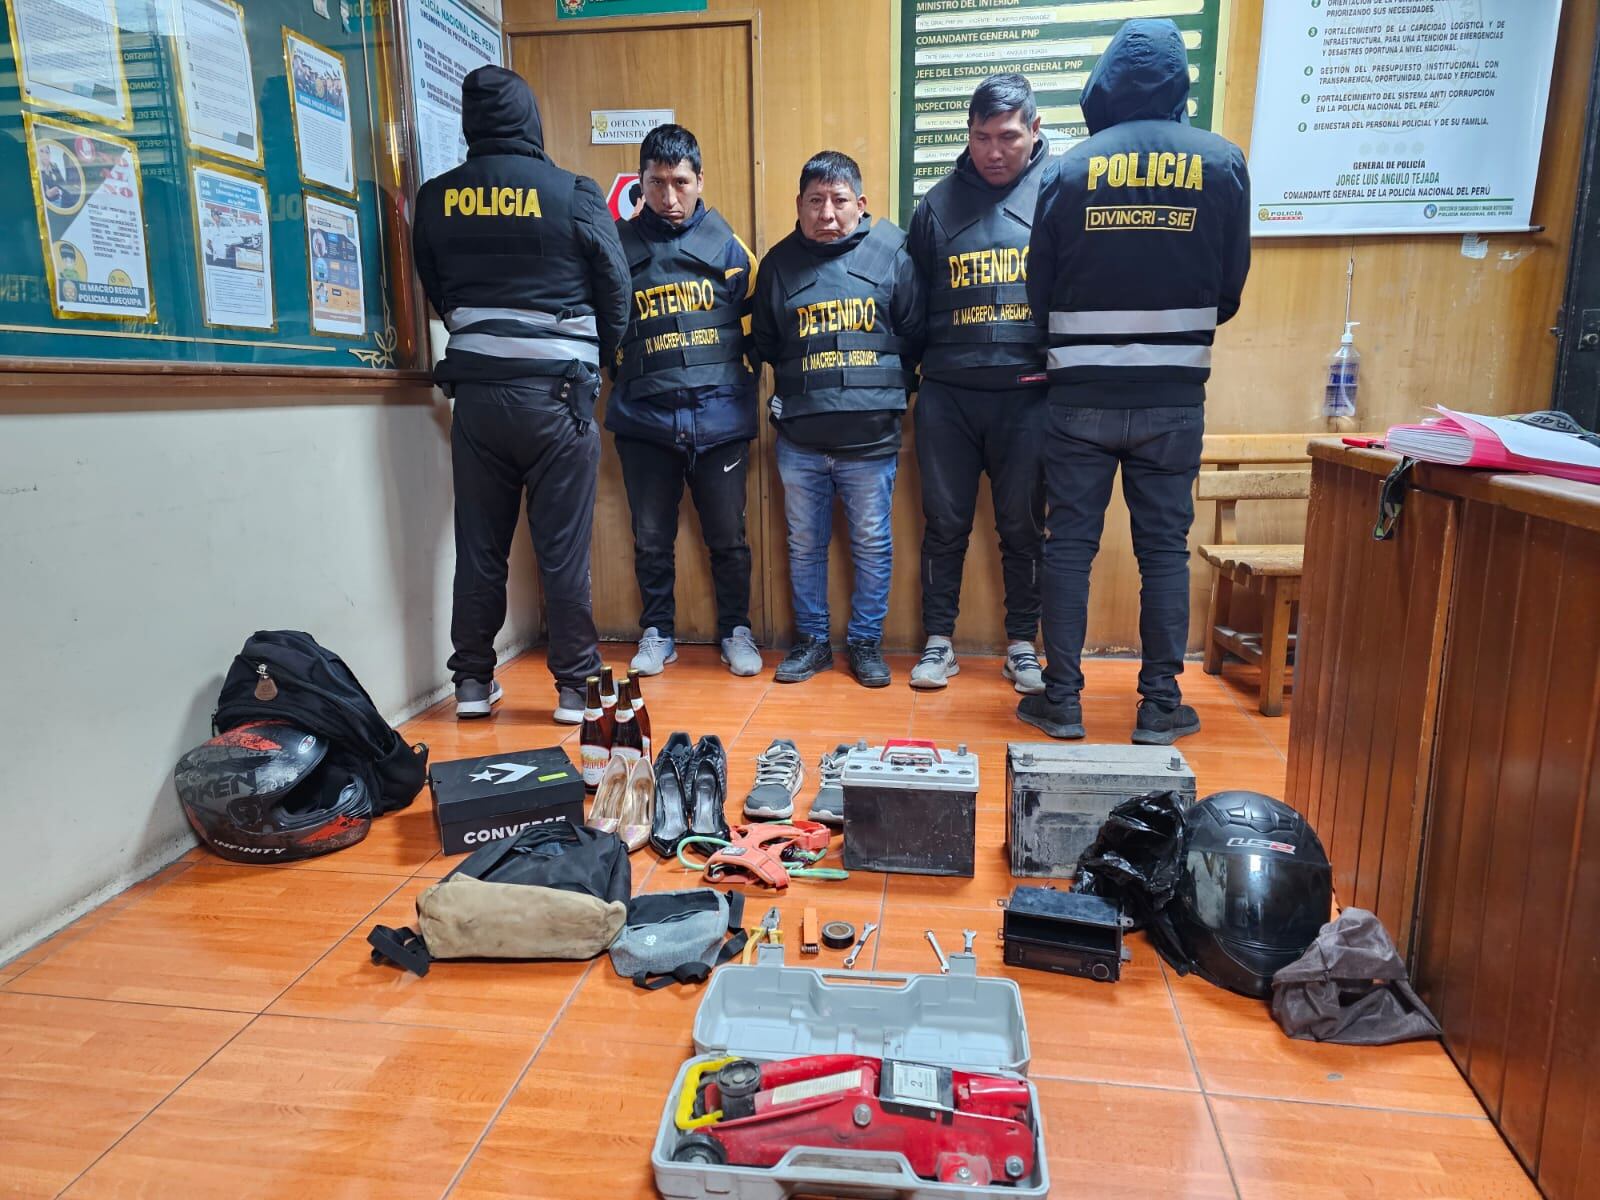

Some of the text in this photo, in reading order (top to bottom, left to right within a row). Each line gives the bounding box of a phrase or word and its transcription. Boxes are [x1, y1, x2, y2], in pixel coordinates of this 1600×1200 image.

[916, 0, 959, 11] MINISTRO
[960, 0, 977, 9] DEL
[1326, 7, 1372, 17] PRIORIZANDO
[1373, 7, 1387, 15] SUS
[1324, 25, 1382, 35] FORTALECIMIENTO
[1385, 24, 1395, 33] DE
[1398, 24, 1407, 32] LA
[1410, 22, 1447, 32] CAPACIDAD
[1488, 20, 1493, 29] Y
[1496, 20, 1506, 29] DE
[916, 29, 1040, 45] COMANDANTE GENERAL PNP
[1384, 35, 1401, 43] PARA
[1402, 34, 1415, 42] UNA
[1449, 32, 1458, 41] DE
[1459, 31, 1504, 41] EMERGENCIAS
[1322, 49, 1327, 57] Y
[1327, 47, 1363, 56] DESASTRES
[1364, 45, 1398, 55] OPORTUNA
[1398, 45, 1404, 54] A
[1405, 44, 1423, 53] NIVEL
[915, 60, 1083, 80] JEFE DEL ESTADO MAYOR GENERAL PNP
[1354, 64, 1367, 73] DEL
[1371, 63, 1422, 73] PRESUPUESTO
[1426, 61, 1480, 70] INSTITUCIONAL
[1484, 60, 1500, 69] CON
[1424, 72, 1453, 81] CALIDAD
[1454, 71, 1459, 80] Y
[1317, 93, 1381, 103] FORTALECIMIENTO
[1382, 92, 1396, 100] DEL
[1398, 91, 1428, 100] SISTEMA
[1429, 90, 1447, 98] ANTI
[915, 101, 963, 112] INSPECTOR
[1315, 105, 1326, 113] EN
[1327, 104, 1335, 112] LA
[1366, 101, 1402, 111] NACIONAL
[1404, 101, 1417, 110] DEL
[610, 119, 659, 128] OFICINA DE
[1313, 122, 1350, 131] BIENESTAR
[1351, 121, 1364, 129] DEL
[1365, 120, 1400, 129] PERSONAL
[1401, 119, 1432, 128] POLICIAL
[1433, 118, 1438, 127] Y
[1440, 118, 1449, 126] DE
[1450, 117, 1460, 126] SU
[597, 130, 650, 139] ADMINISTRA
[914, 134, 933, 145] JEFE
[934, 133, 943, 143] IX
[1353, 161, 1385, 170] GENERAL
[1386, 161, 1395, 169] DE
[914, 168, 933, 177] JEFE
[1336, 171, 1440, 187] JORGE LUIS ANGULO TEJADA
[1283, 190, 1332, 200] COMANDANTE
[1332, 188, 1365, 199] GENERAL
[1366, 188, 1377, 198] DE
[1377, 187, 1387, 197] LA
[1418, 187, 1455, 197] NACIONAL
[1456, 186, 1470, 196] DEL
[1090, 210, 1156, 226] DIVINCRI
[1167, 211, 1192, 227] SIE
[87, 286, 114, 295] MACRO
[78, 293, 143, 307] POLICIAL AREQUIPA
[634, 278, 714, 321] DETENIDO
[796, 297, 876, 338] DETENIDO
[961, 304, 998, 324] MACREPOL
[654, 330, 690, 351] MACREPOL
[691, 327, 720, 346] AREQUIPA
[810, 350, 847, 370] MACREPOL
[848, 350, 879, 367] AREQUIPA
